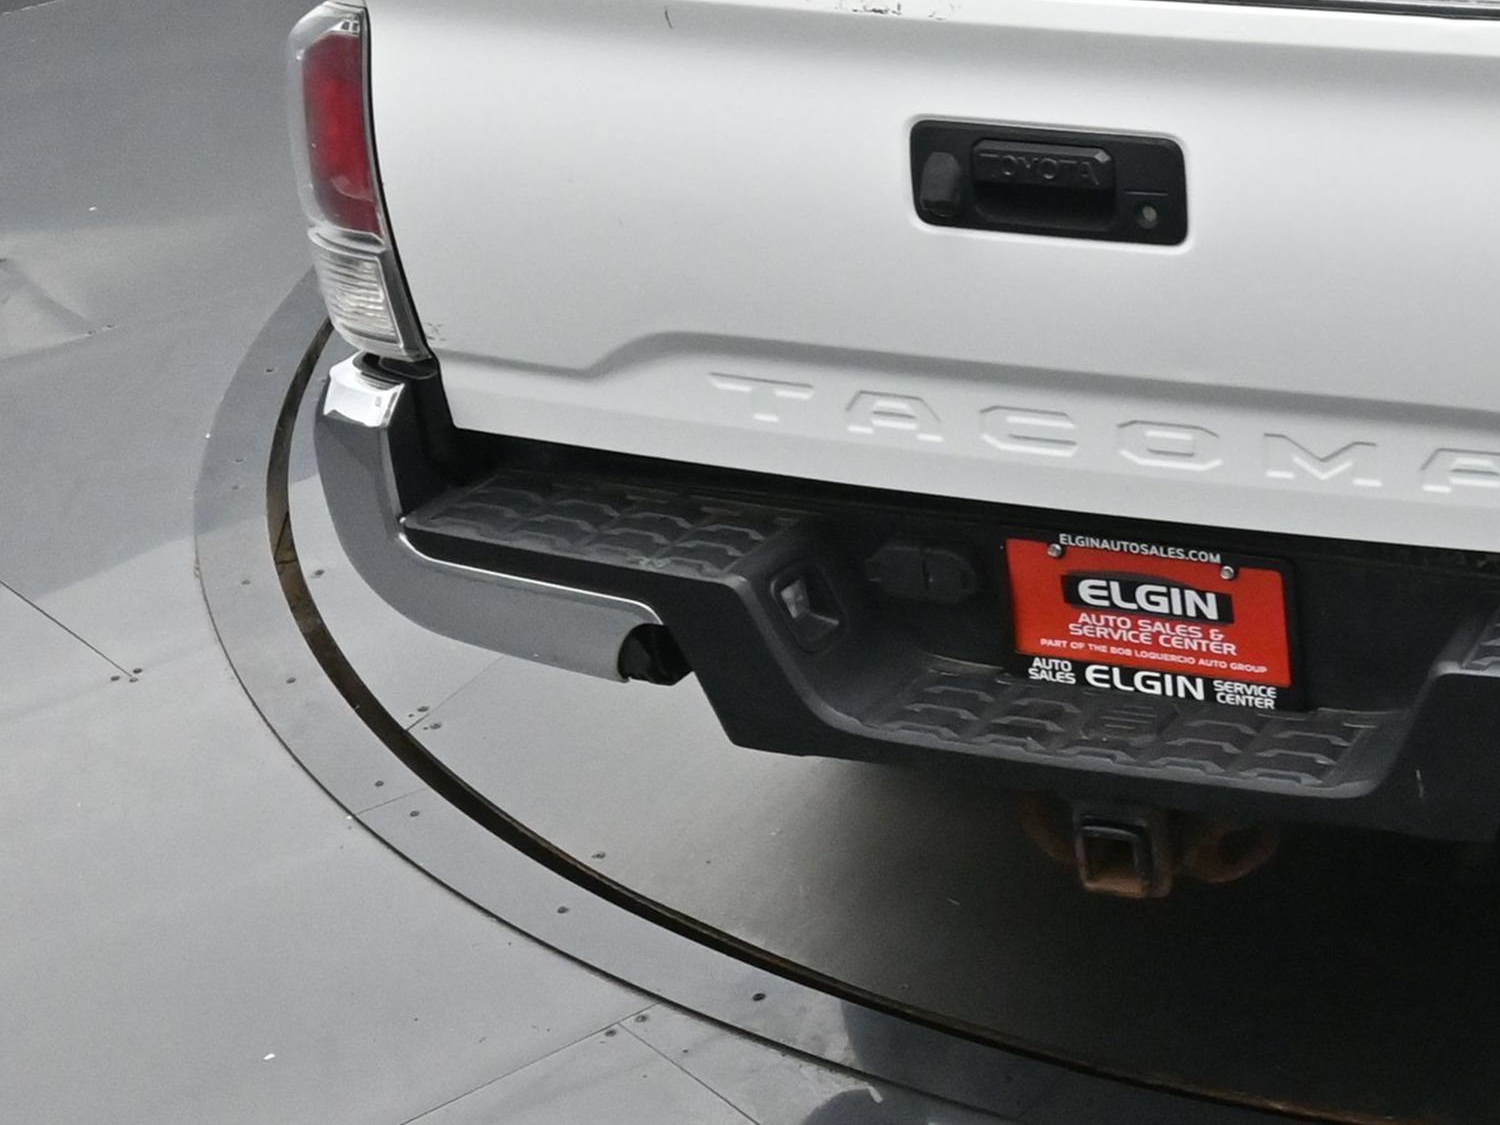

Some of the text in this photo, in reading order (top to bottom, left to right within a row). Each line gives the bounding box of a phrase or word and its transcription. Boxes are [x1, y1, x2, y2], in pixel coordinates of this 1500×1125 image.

[1059, 533, 1221, 565] ELGINAUTOSALES.COM
[1078, 578, 1218, 621] ELGIN
[1068, 623, 1237, 656] SERVICE CENTER
[1078, 612, 1225, 641] AUTO SALES &
[1031, 657, 1072, 672] AUTO
[1040, 638, 1068, 648] PART
[1070, 641, 1084, 650] OF
[1088, 643, 1108, 653] THE
[1110, 646, 1132, 656] BOB
[1198, 658, 1227, 668] AUTO
[1230, 662, 1268, 674] GROUP
[1028, 668, 1076, 685] SALES
[1084, 664, 1205, 701] ELGIN
[1213, 680, 1277, 699] SERVICE
[1216, 693, 1276, 710] CENTER
